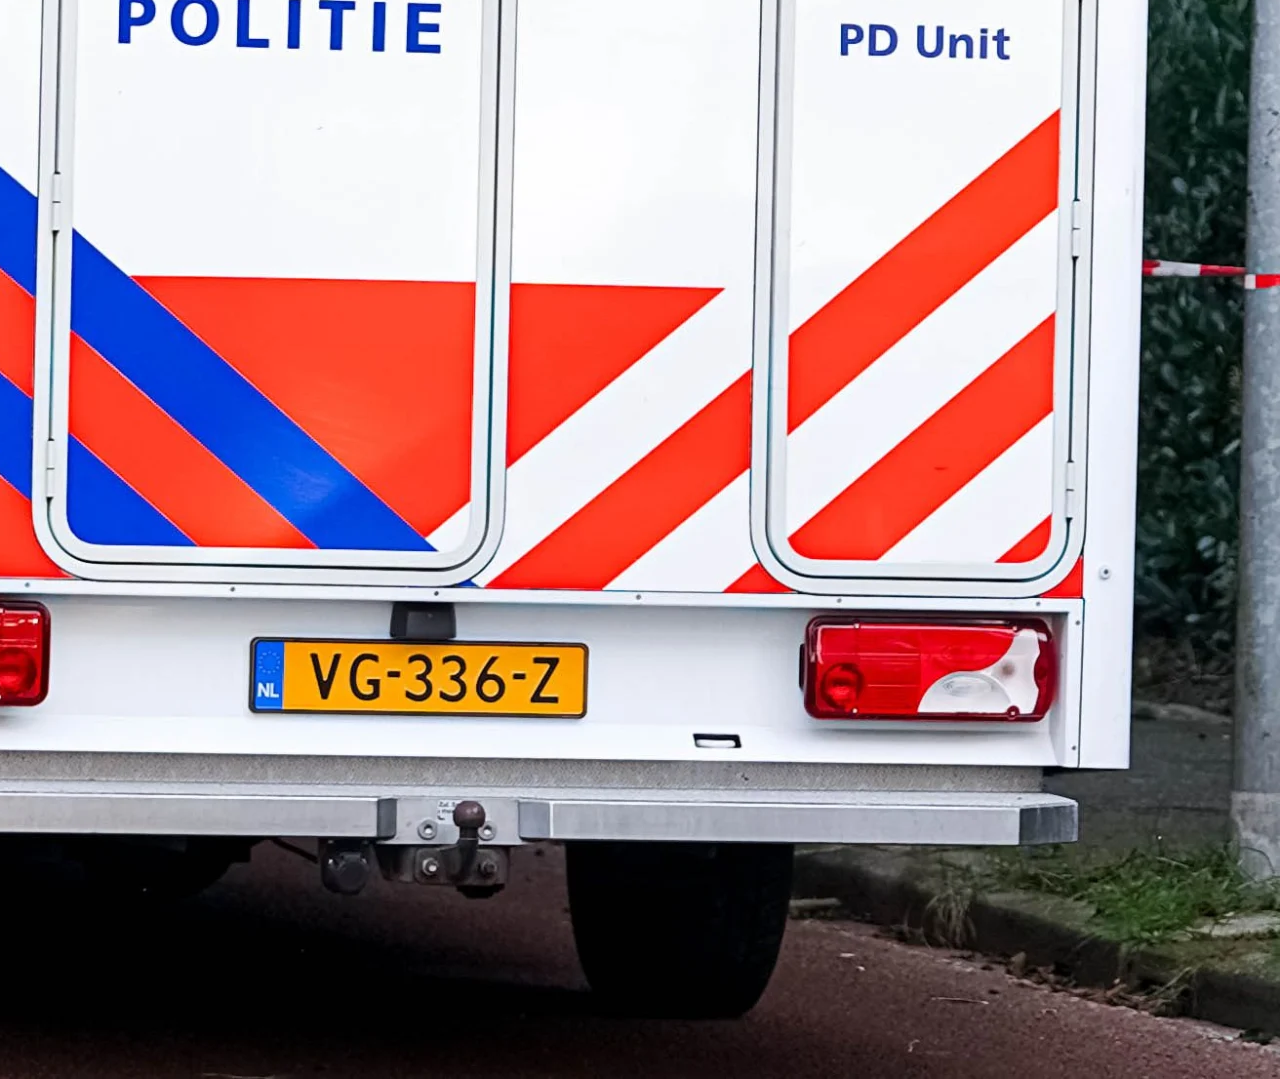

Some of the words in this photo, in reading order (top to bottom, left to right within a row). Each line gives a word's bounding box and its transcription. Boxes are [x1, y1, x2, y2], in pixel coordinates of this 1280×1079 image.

[840, 23, 898, 58] PD
[917, 25, 1010, 61] Unit
[257, 682, 280, 699] NL
[310, 652, 561, 704] VG-336-Z
